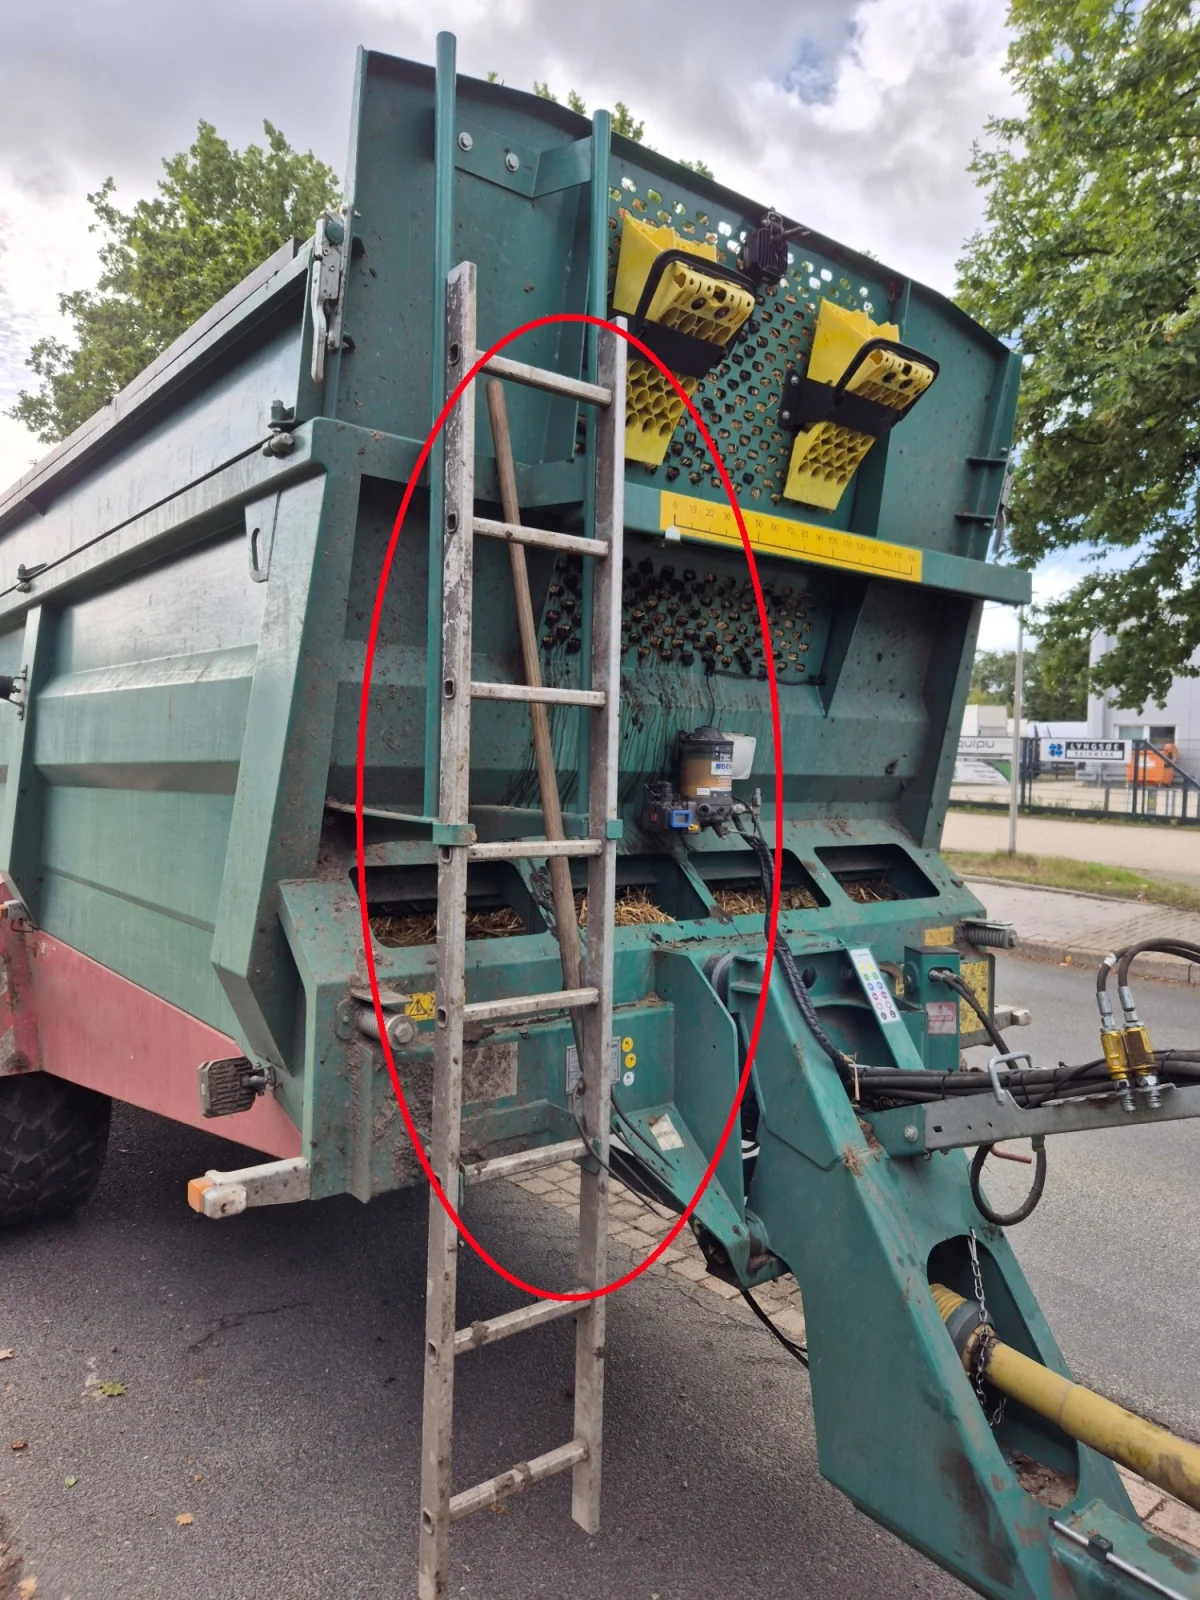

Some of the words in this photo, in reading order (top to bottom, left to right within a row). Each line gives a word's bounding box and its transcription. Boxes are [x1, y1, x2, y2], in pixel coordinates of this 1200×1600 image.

[673, 501, 678, 510] 0
[689, 504, 697, 514] 10
[705, 508, 714, 518] 20
[723, 512, 731, 522] 30
[755, 519, 763, 529] 50
[770, 523, 779, 533] 60
[786, 525, 794, 536] 70
[801, 530, 809, 540] 80
[816, 533, 824, 541] 90
[828, 536, 838, 546] 100
[843, 539, 853, 548] 110
[856, 542, 866, 552] 120
[868, 546, 878, 555] 130
[882, 550, 892, 558] 140
[894, 551, 903, 560] 150
[1070, 743, 1120, 751] LYNGSØE
